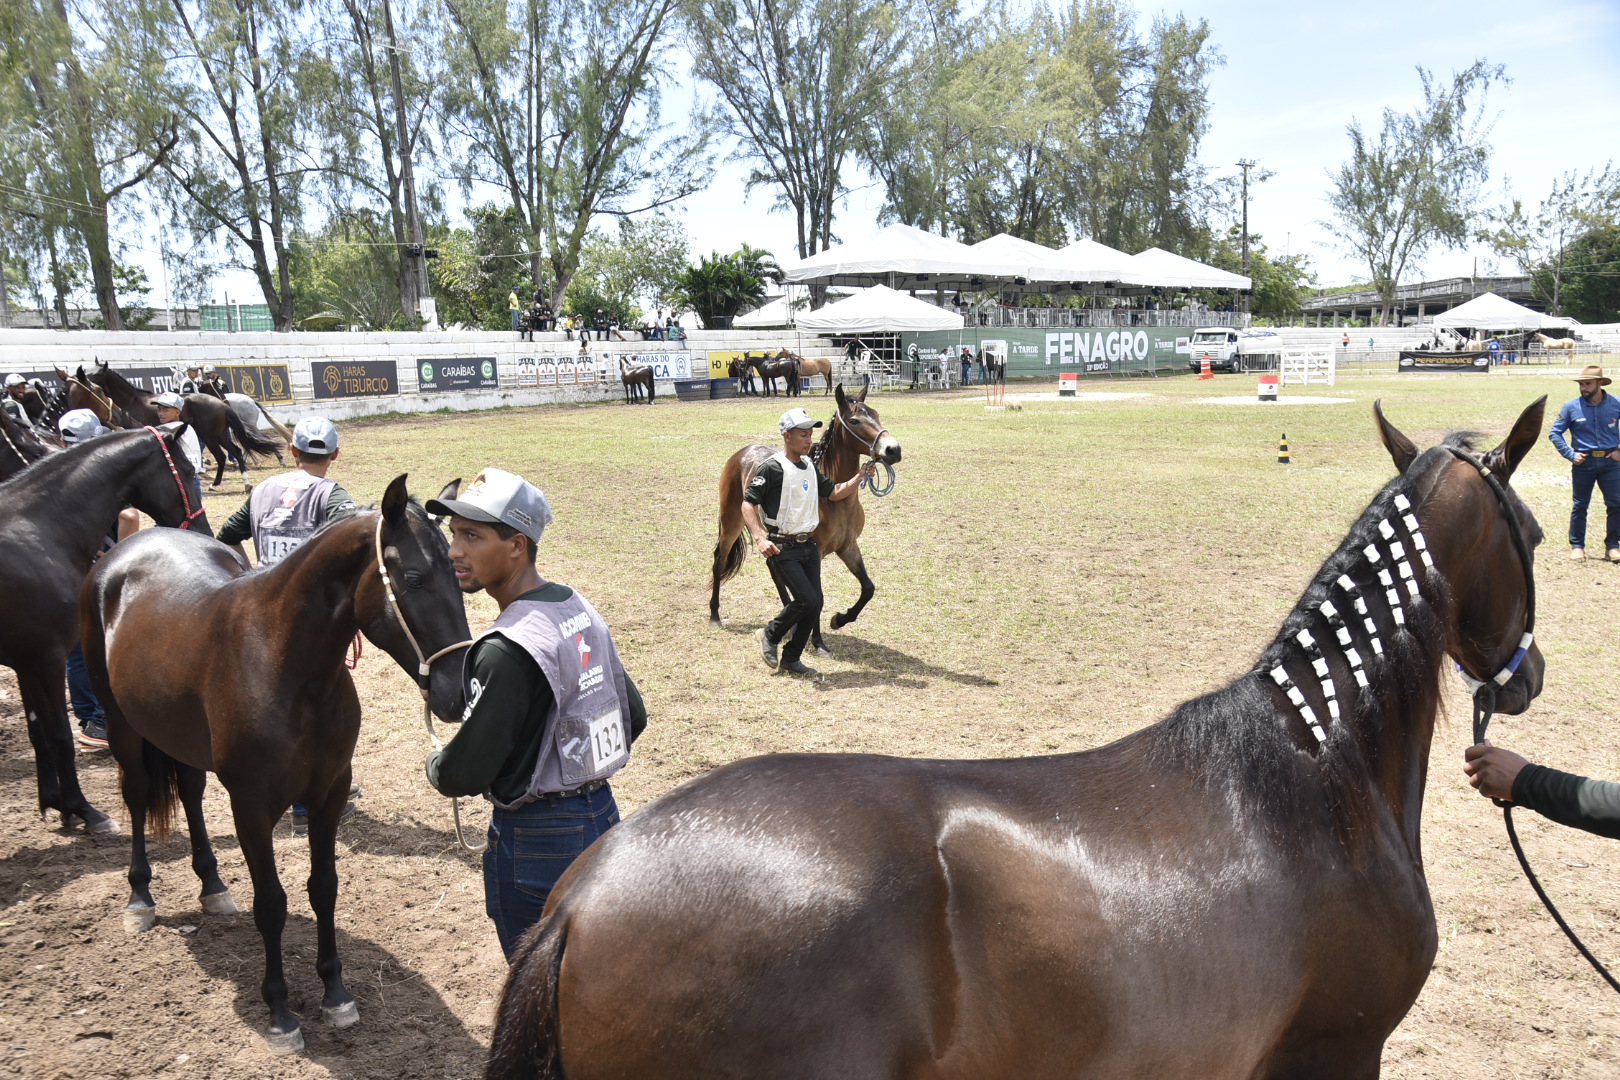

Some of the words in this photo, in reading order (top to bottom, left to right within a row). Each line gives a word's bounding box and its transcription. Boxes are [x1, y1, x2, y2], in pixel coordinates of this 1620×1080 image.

[1018, 345, 1039, 353] TARDE
[1045, 330, 1149, 365] FENAGRO
[660, 355, 670, 363] DO
[342, 366, 366, 377] HARAS
[441, 364, 476, 378] CARAÍBAS
[343, 377, 389, 393] TIBURCIO
[594, 722, 622, 763] 132
